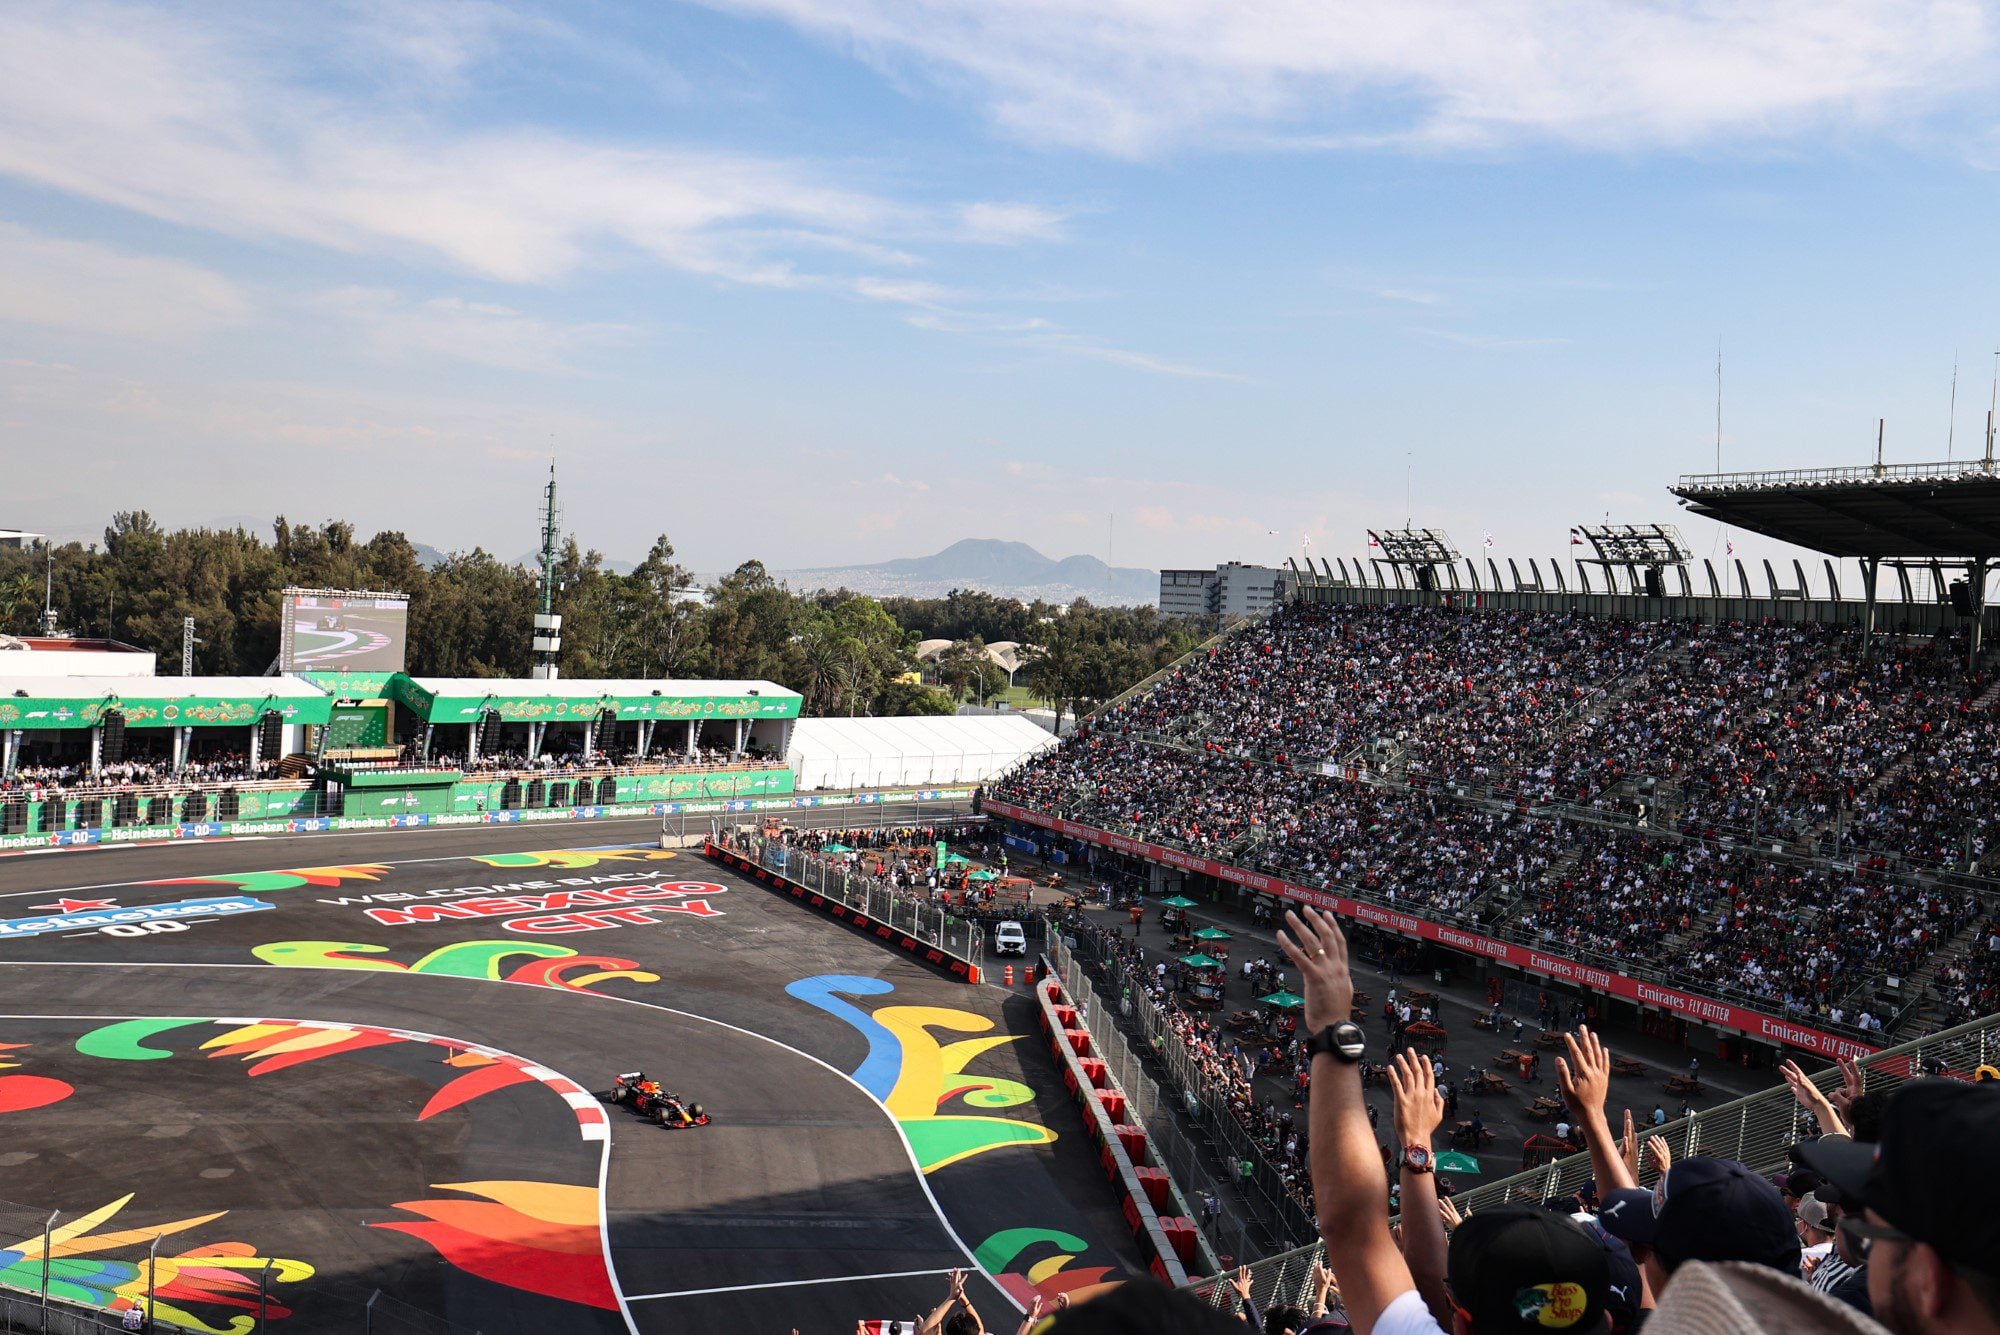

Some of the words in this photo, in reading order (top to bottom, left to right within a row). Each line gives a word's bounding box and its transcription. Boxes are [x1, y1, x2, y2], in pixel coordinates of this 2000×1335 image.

[526, 808, 567, 820] Heineken
[610, 805, 647, 816] Heineken
[686, 802, 721, 812] Heineken
[338, 817, 386, 829] Heineken
[436, 812, 480, 824] Heineken
[112, 826, 170, 841] Heineken
[231, 821, 284, 834] Heineken
[1162, 850, 1184, 865] Emirates
[1220, 866, 1245, 882] Emirates
[317, 881, 561, 905] WELCOME
[557, 871, 676, 885] BACK
[1284, 885, 1312, 901] Emirates
[1314, 894, 1322, 903] FLY
[1322, 896, 1338, 909] BETTER
[502, 899, 726, 934] CITY
[1356, 906, 1388, 924] Emirates
[1390, 914, 1400, 927] FLY
[1400, 917, 1417, 932] BETTER
[1438, 928, 1474, 948] Emirates
[1476, 938, 1488, 952] FLY
[1487, 941, 1507, 958] BETTER
[1530, 954, 1572, 976] Emirates
[1574, 966, 1587, 982] FLY
[1586, 970, 1610, 988] BETTER
[1637, 984, 1684, 1009] Emirates
[1688, 998, 1703, 1014] FLY
[1702, 1002, 1730, 1022] BETTER
[1762, 1018, 1818, 1048] Emirates
[1822, 1036, 1836, 1052] FLY
